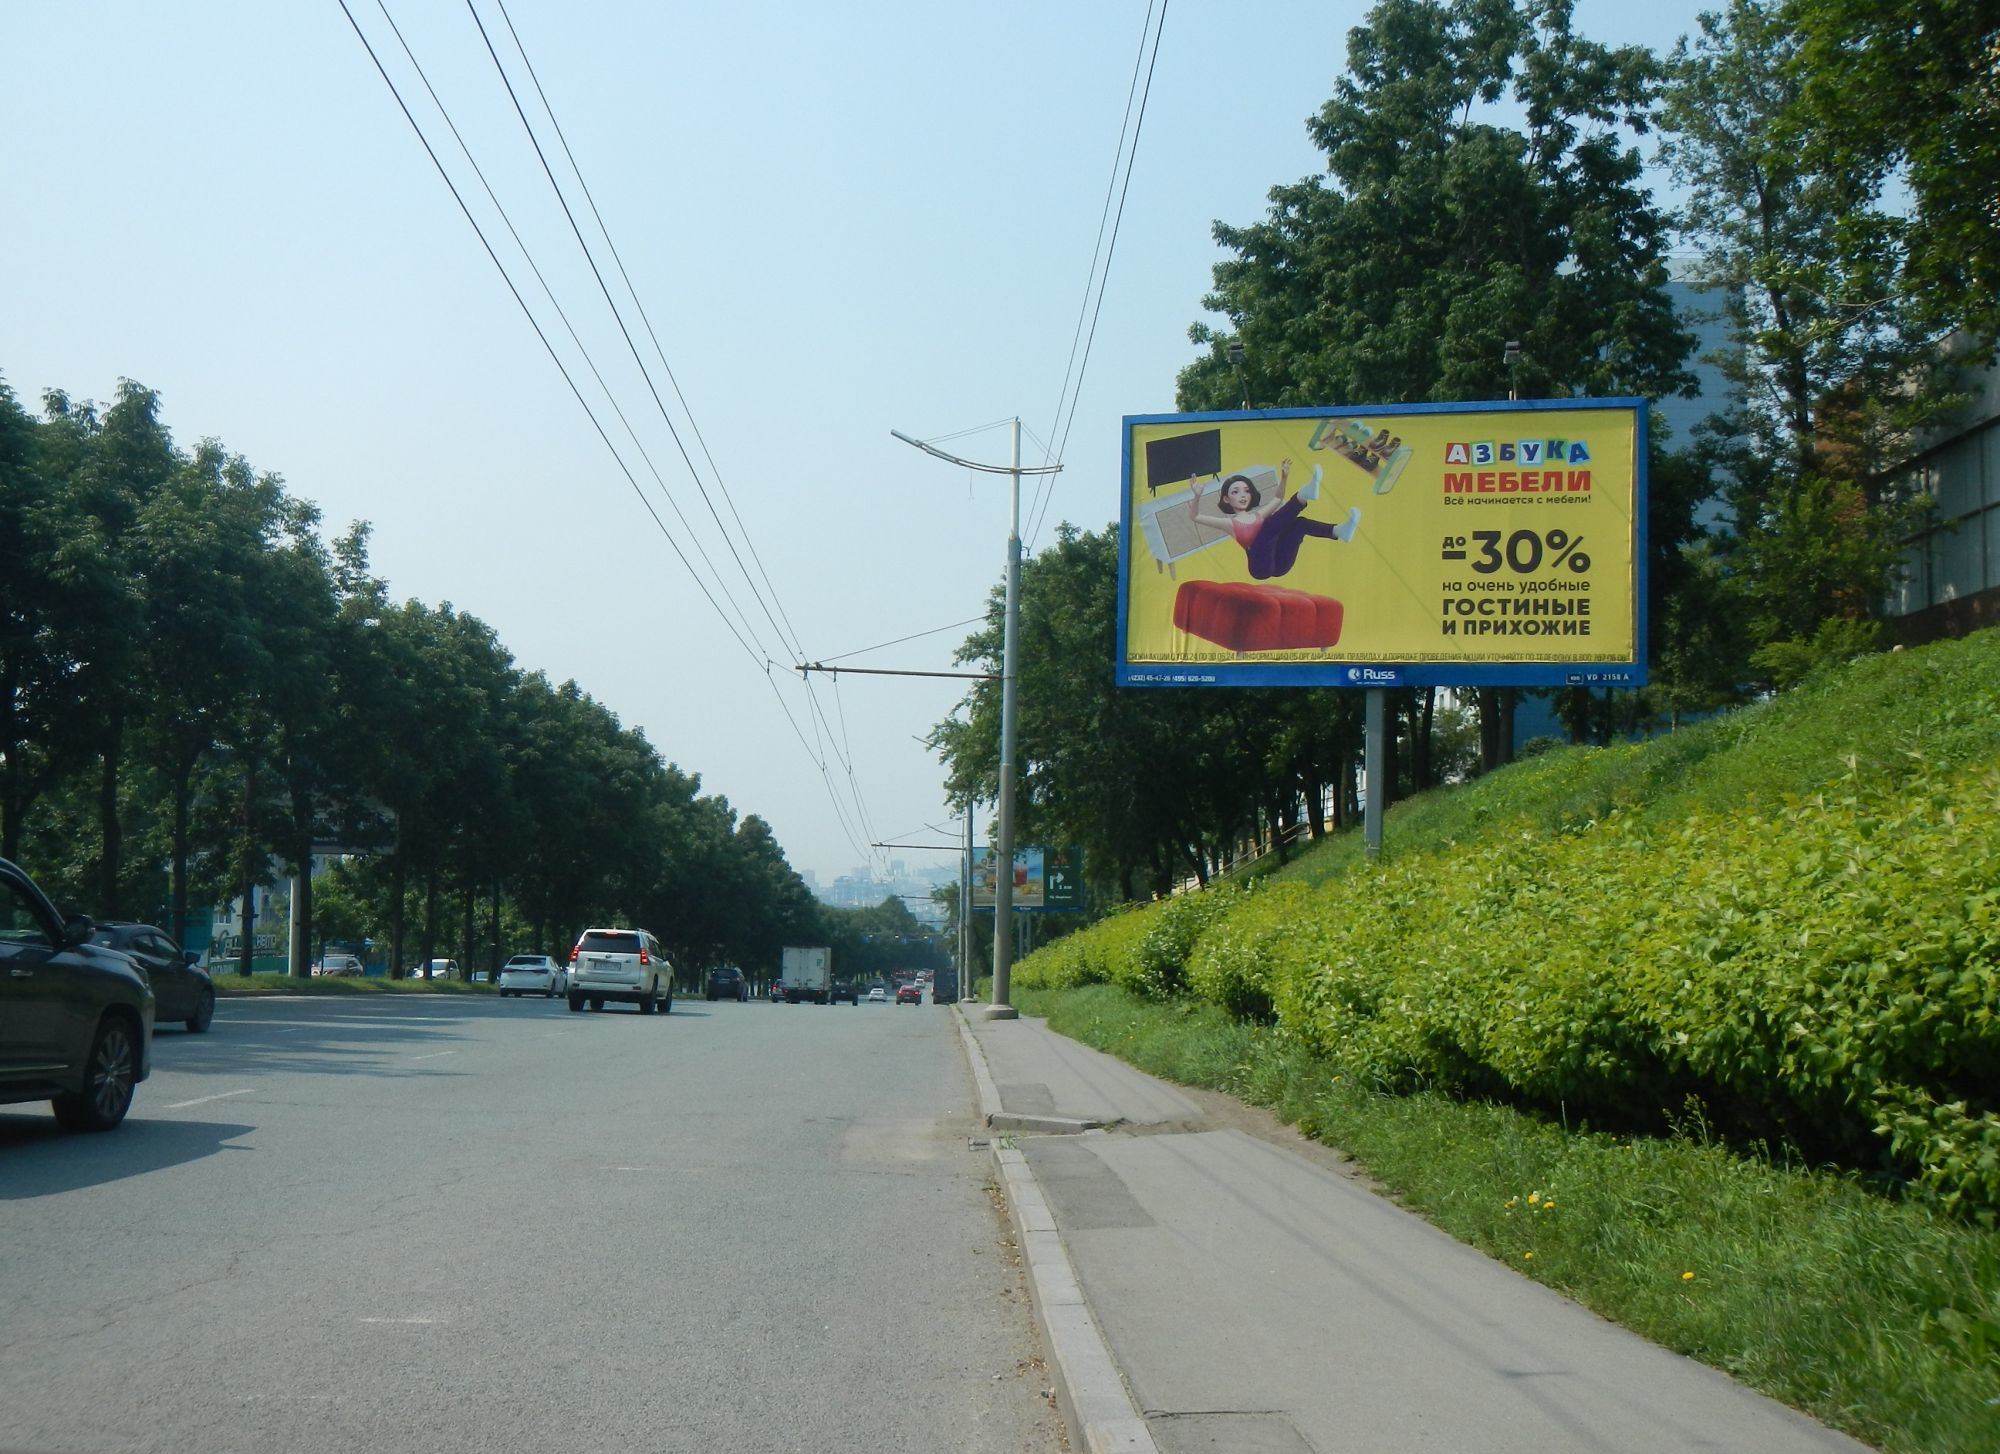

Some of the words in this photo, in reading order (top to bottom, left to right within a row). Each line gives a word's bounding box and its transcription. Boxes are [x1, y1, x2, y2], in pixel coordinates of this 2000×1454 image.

[1446, 438, 1591, 465] АЗБУКА
[1443, 470, 1591, 493] МЕБЕЛИ
[1443, 496, 1465, 506] Всё
[1467, 496, 1534, 505] начинается
[1536, 496, 1543, 504] с
[1546, 494, 1592, 504] мебели!
[1442, 536, 1467, 549] до
[1442, 582, 1462, 592] на
[1467, 580, 1515, 592] очень
[1520, 578, 1591, 595] удобные
[1442, 598, 1591, 616] ГОСТИНЫЕ
[1442, 620, 1456, 636] И
[1464, 620, 1591, 636] ПРИХОЖИЕ
[1363, 668, 1396, 680] Russ
